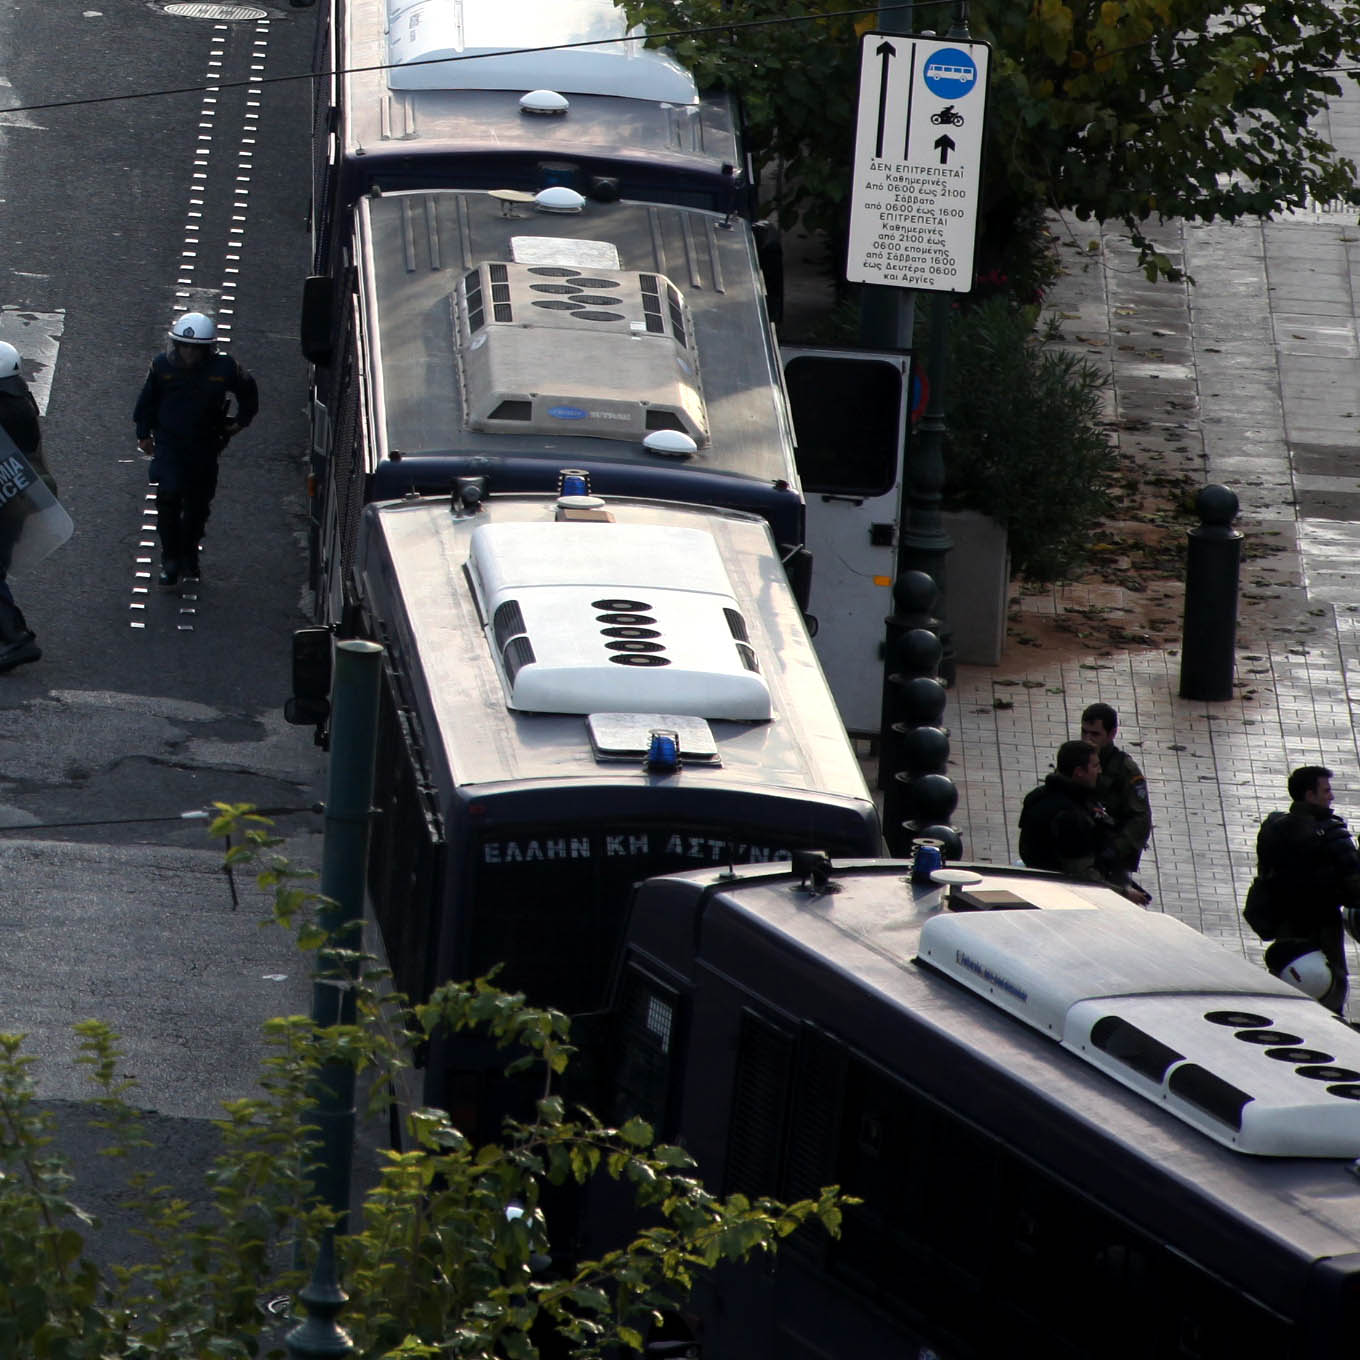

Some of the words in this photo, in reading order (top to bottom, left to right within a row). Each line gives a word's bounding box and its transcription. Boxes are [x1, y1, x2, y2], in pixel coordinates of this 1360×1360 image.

[870, 162, 892, 172] ΔΕΝ
[896, 165, 964, 178] ΕΠΙΤΡΕΠΕΤΑΙ
[886, 174, 947, 188] Καθημερινές
[865, 182, 884, 191] Από
[887, 183, 915, 194] 06:00
[918, 187, 938, 197] έως
[940, 188, 966, 198] 21:00
[894, 194, 935, 205] Σάββατο
[865, 202, 882, 210] από
[885, 203, 913, 213] 06:00
[916, 206, 935, 217] έως
[940, 208, 964, 218] 16:00
[879, 212, 948, 226] ΕΠΙΤΡΕΠΕΤΑΙ
[882, 223, 943, 237] Καθημερινές
[878, 233, 896, 241] από
[899, 234, 924, 243] 21:00
[927, 237, 946, 247] έως
[873, 241, 901, 251] 06:00
[904, 245, 950, 257] επομένης
[866, 251, 883, 259] από
[886, 252, 927, 264] Σάββατο
[931, 256, 956, 266] 16:00
[863, 259, 882, 270] έως
[886, 261, 926, 273] Δευτέρα
[928, 266, 957, 276] 06:00
[902, 273, 935, 285] Αργίες
